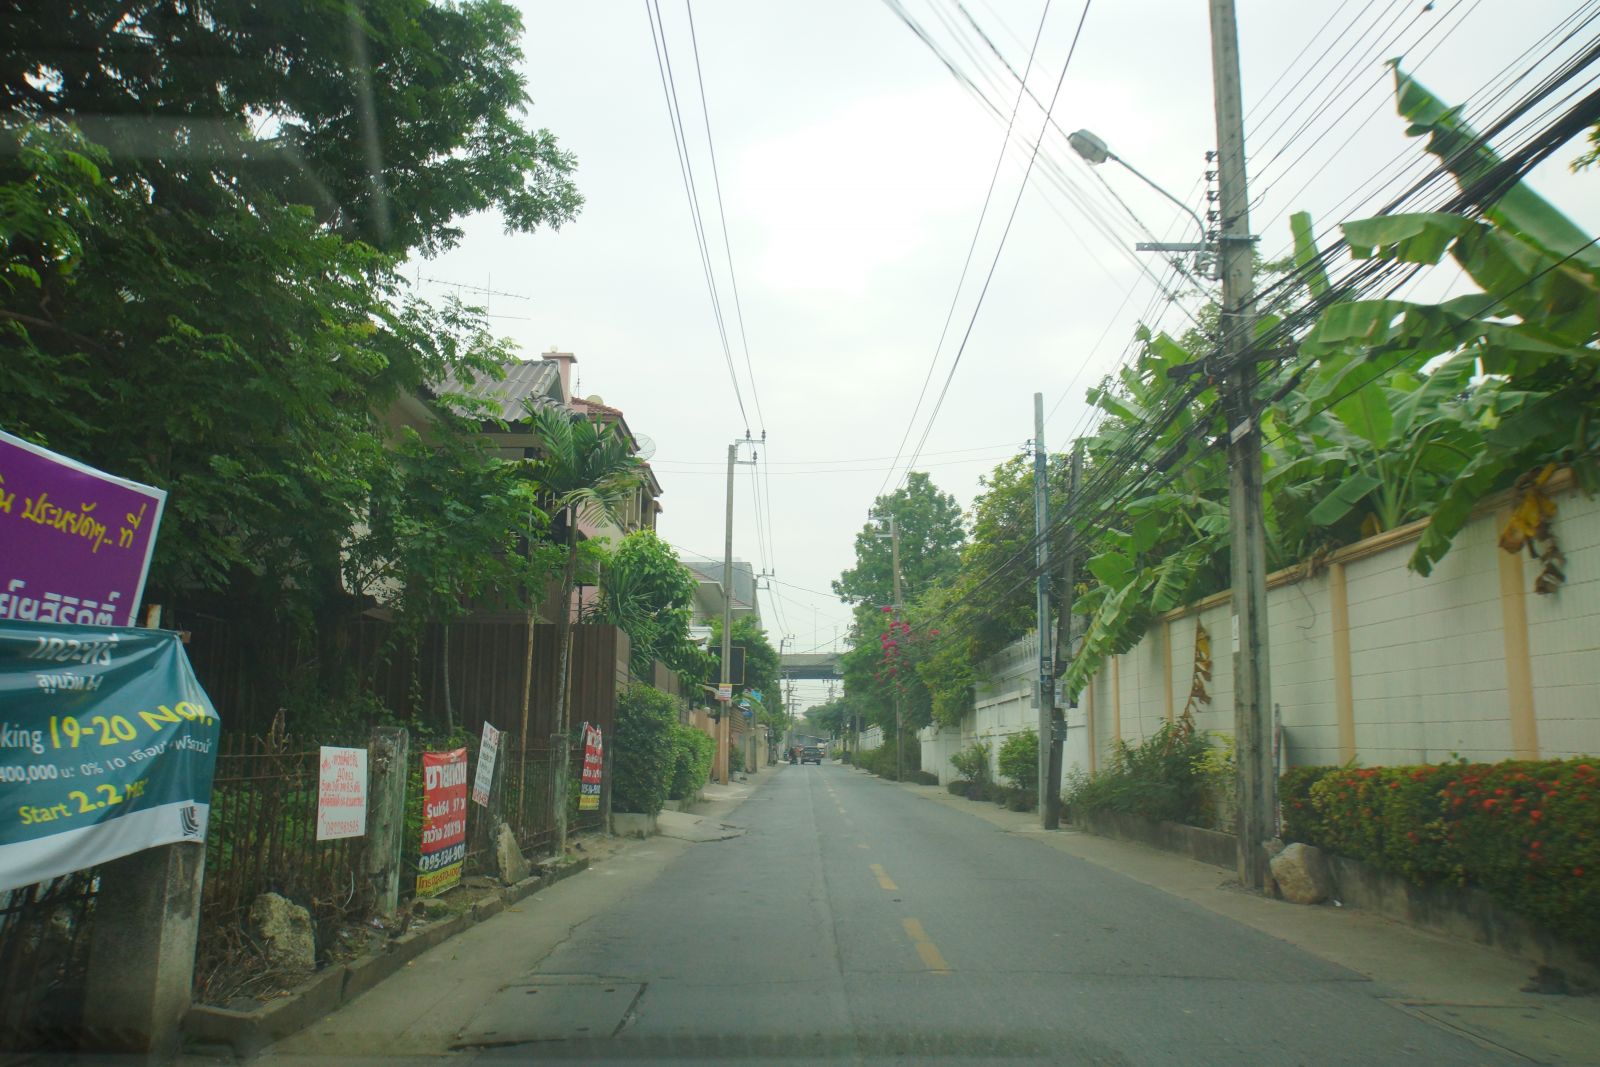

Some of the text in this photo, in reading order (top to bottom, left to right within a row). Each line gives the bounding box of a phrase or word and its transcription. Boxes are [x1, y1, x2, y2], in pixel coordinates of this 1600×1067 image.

[50, 714, 138, 749] 19-20
[18, 803, 73, 825] Start
[68, 783, 124, 814] 2.2
